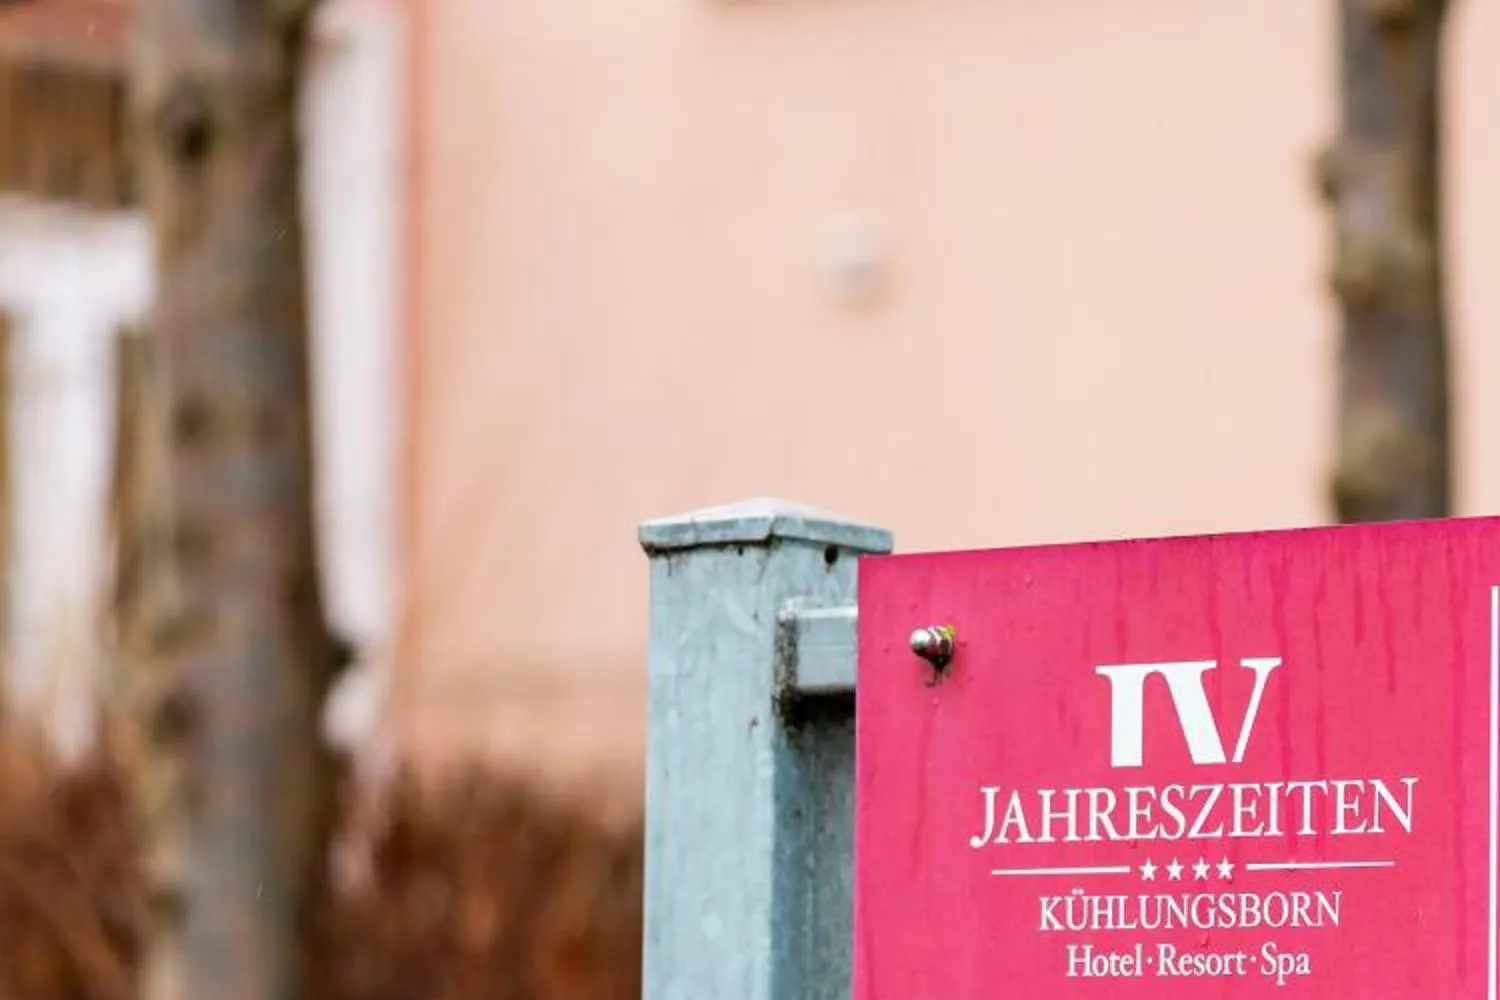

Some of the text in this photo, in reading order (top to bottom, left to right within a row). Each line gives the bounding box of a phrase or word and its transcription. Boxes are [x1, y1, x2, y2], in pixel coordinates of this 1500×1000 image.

[1095, 656, 1282, 769] IV
[969, 777, 1419, 849] JAHRESZEITEN
[1038, 887, 1342, 932] KÜHLUNGSBORN
